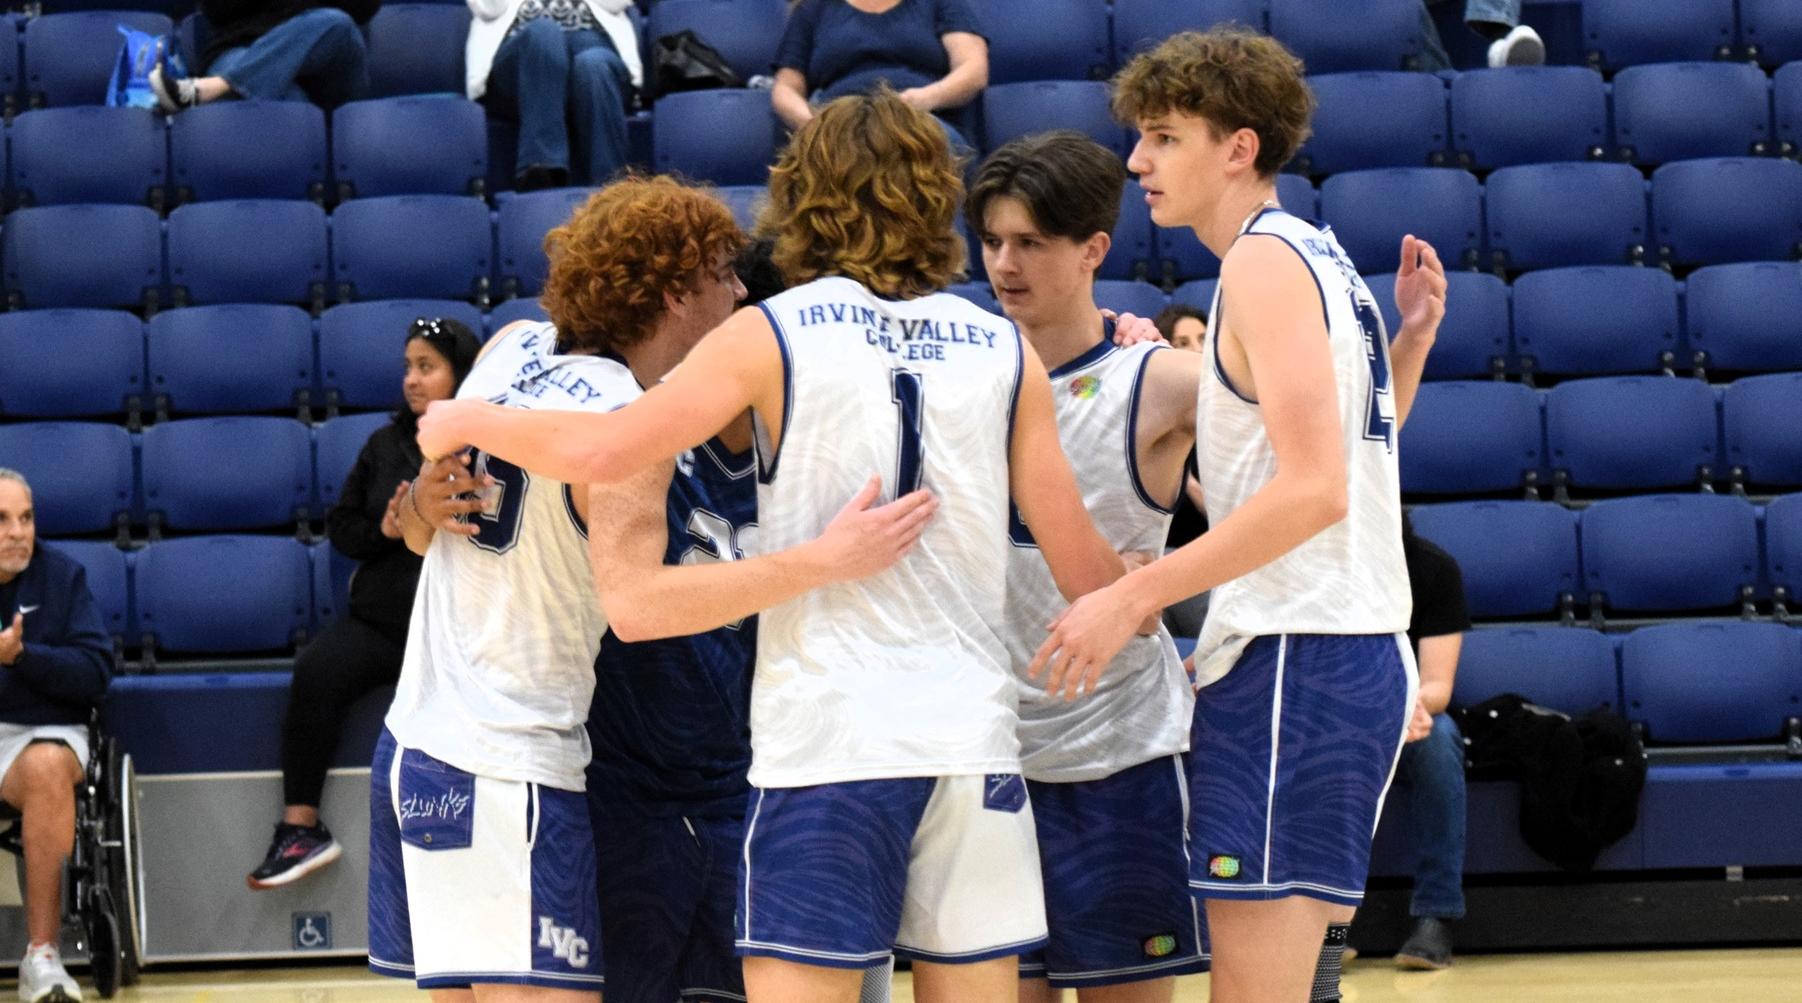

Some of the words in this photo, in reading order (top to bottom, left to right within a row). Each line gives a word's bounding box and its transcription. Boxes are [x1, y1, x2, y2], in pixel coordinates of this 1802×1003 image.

[899, 319, 997, 348] VALLEY
[891, 367, 925, 502] 1
[537, 916, 589, 969] IVC
